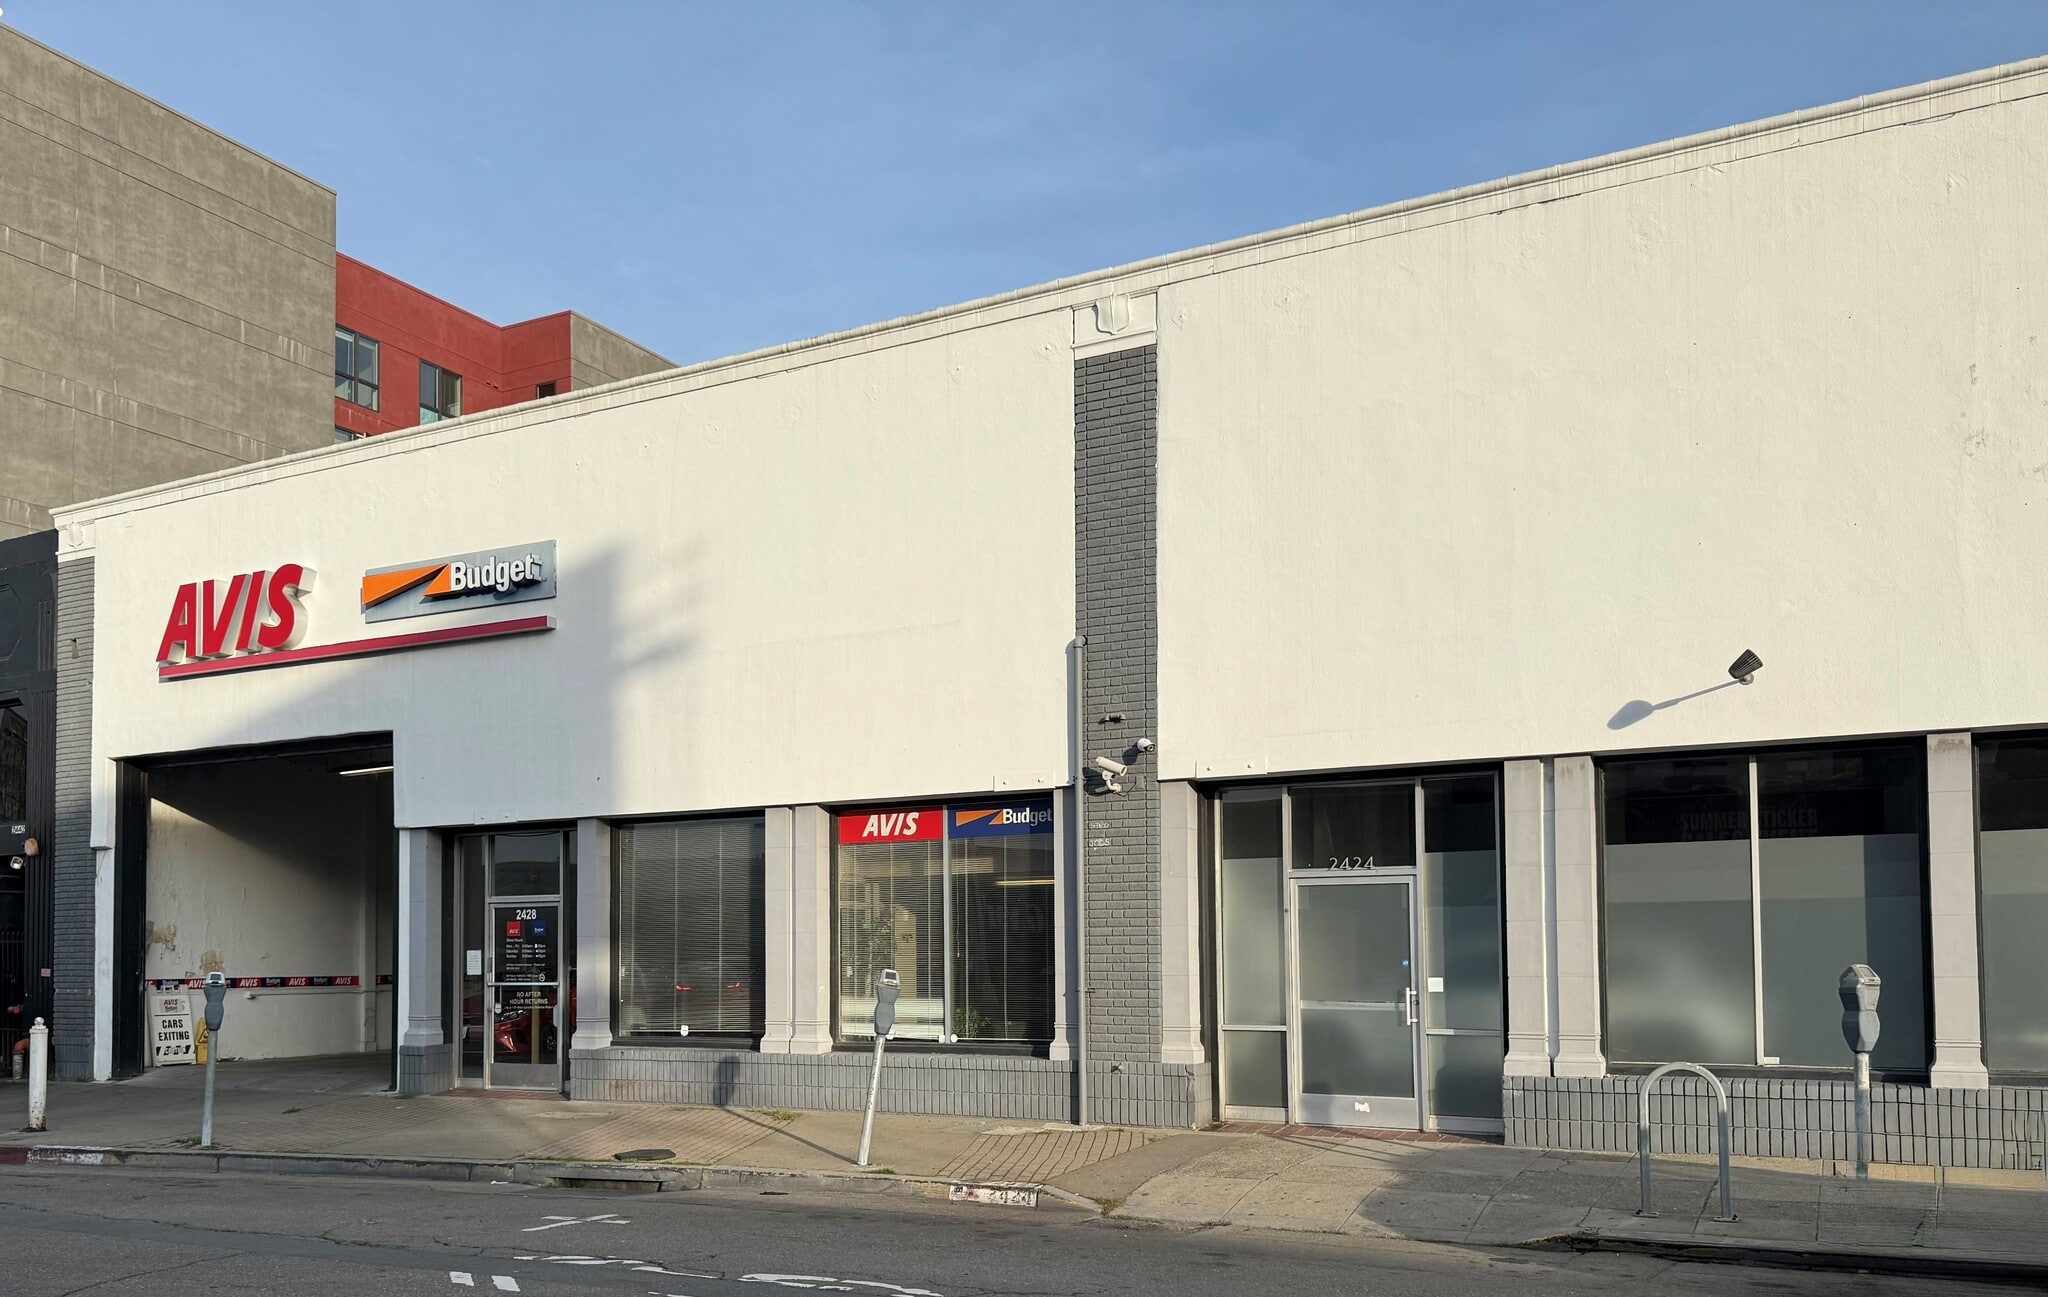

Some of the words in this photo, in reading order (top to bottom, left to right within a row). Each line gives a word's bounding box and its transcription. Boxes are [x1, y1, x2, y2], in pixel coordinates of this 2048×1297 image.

[450, 553, 541, 592] Budget
[156, 563, 310, 663] AVIS
[862, 812, 919, 837] AVIS
[1002, 808, 1053, 826] Budget
[1759, 808, 1818, 829] TICKER
[1329, 856, 1374, 870] 2424
[516, 909, 537, 920] 2428
[240, 979, 258, 987] AVIS
[289, 978, 306, 986] AVIS
[335, 977, 351, 985] AVIS
[162, 1019, 183, 1029] CARS
[158, 1031, 190, 1041] EXITING
